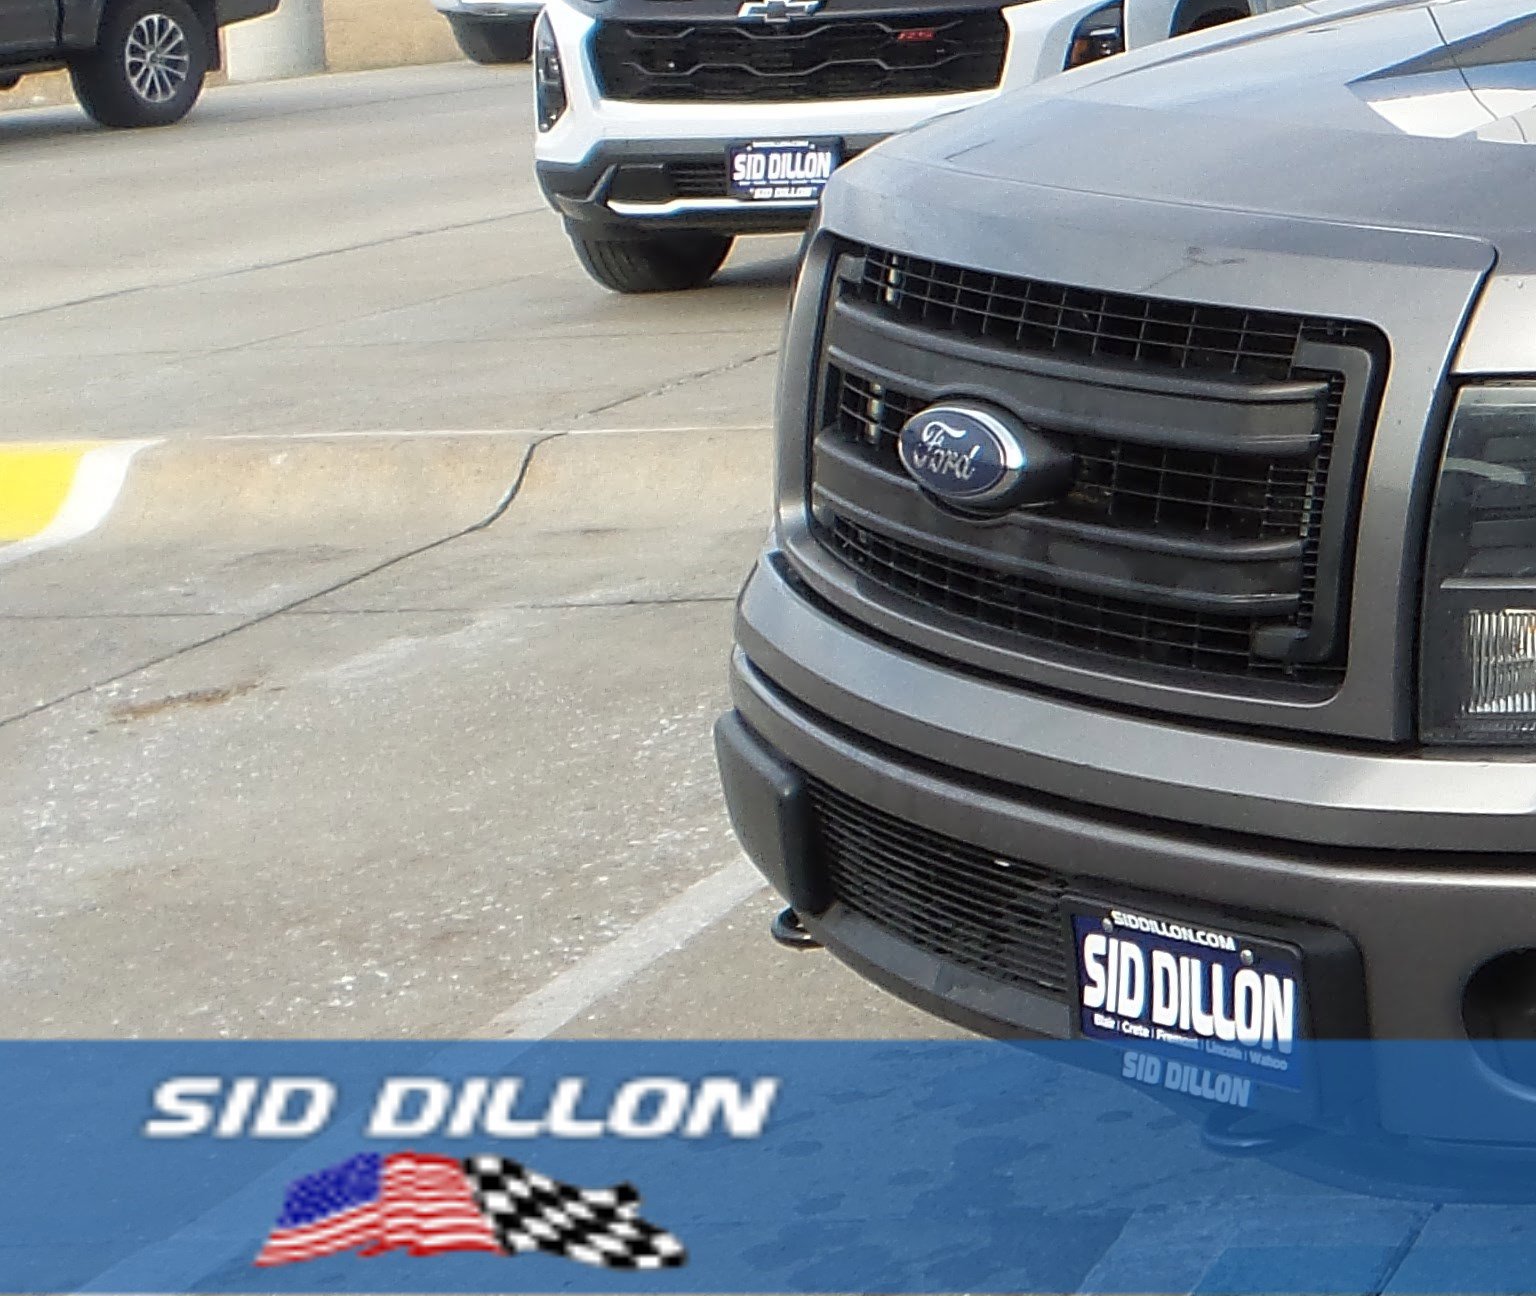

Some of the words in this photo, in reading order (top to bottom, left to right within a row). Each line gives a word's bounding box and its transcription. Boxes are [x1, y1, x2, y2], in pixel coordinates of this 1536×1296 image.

[733, 152, 767, 182] SID
[767, 150, 832, 181] DILLON
[912, 421, 980, 480] Ford
[1111, 910, 1236, 951] SIDDILLON.COM
[1083, 933, 1145, 1019] SID
[1151, 949, 1294, 1054] DILLON
[1121, 1050, 1161, 1085] SID
[1165, 1060, 1251, 1107] DILLON
